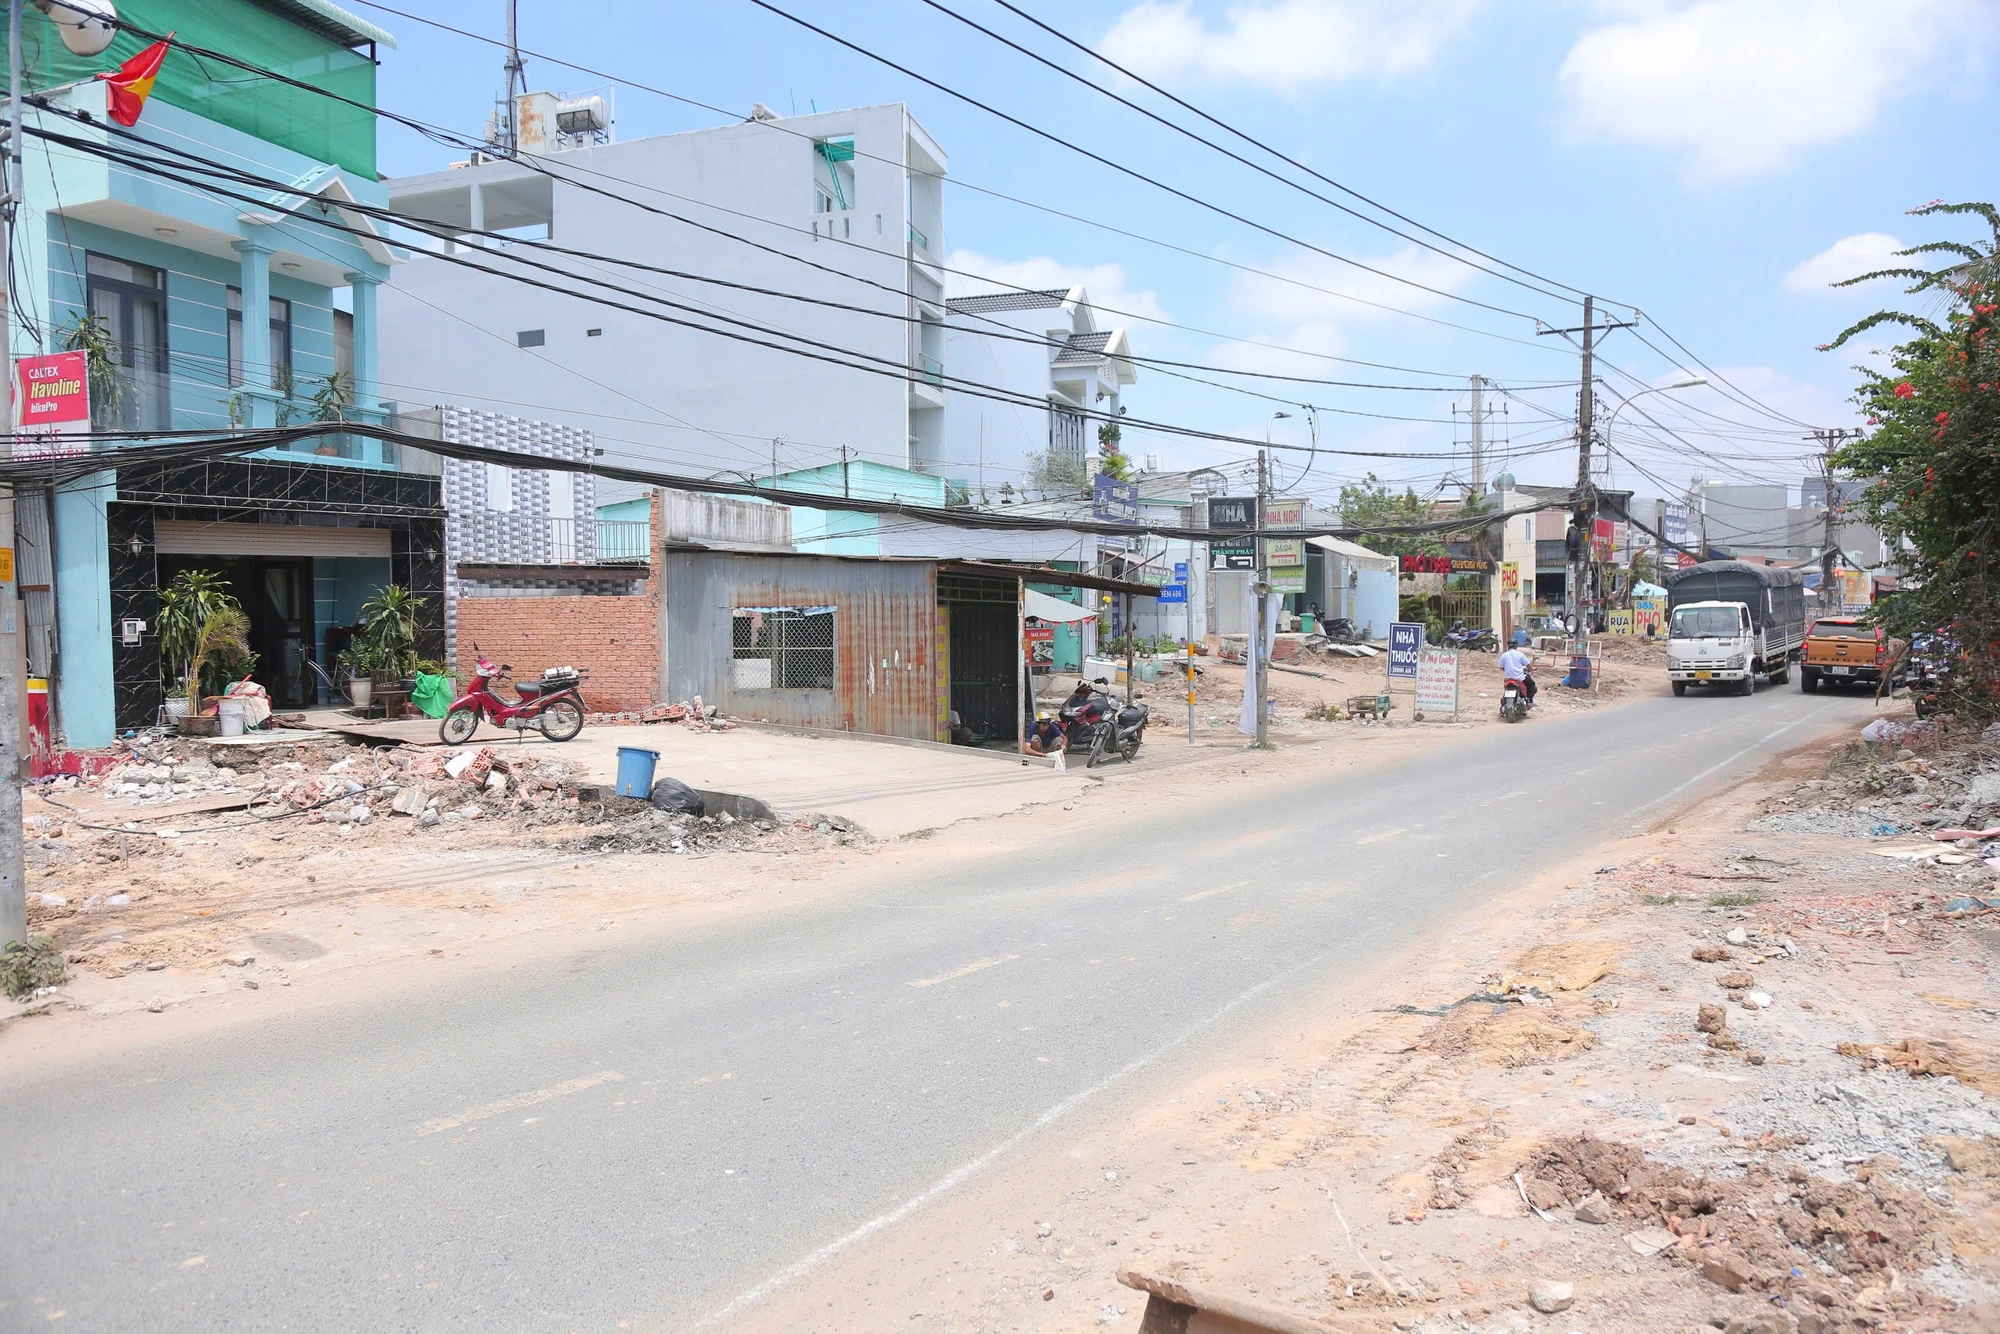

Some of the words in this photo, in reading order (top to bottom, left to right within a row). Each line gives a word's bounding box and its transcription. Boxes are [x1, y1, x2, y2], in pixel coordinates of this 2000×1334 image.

[28, 366, 59, 380] CALTEX
[31, 378, 81, 399] Havoline
[1213, 502, 1246, 522] NHÀ
[1267, 508, 1282, 524] NHÀ
[1396, 628, 1415, 644] NHÀ
[1392, 646, 1417, 663] THUỐC
